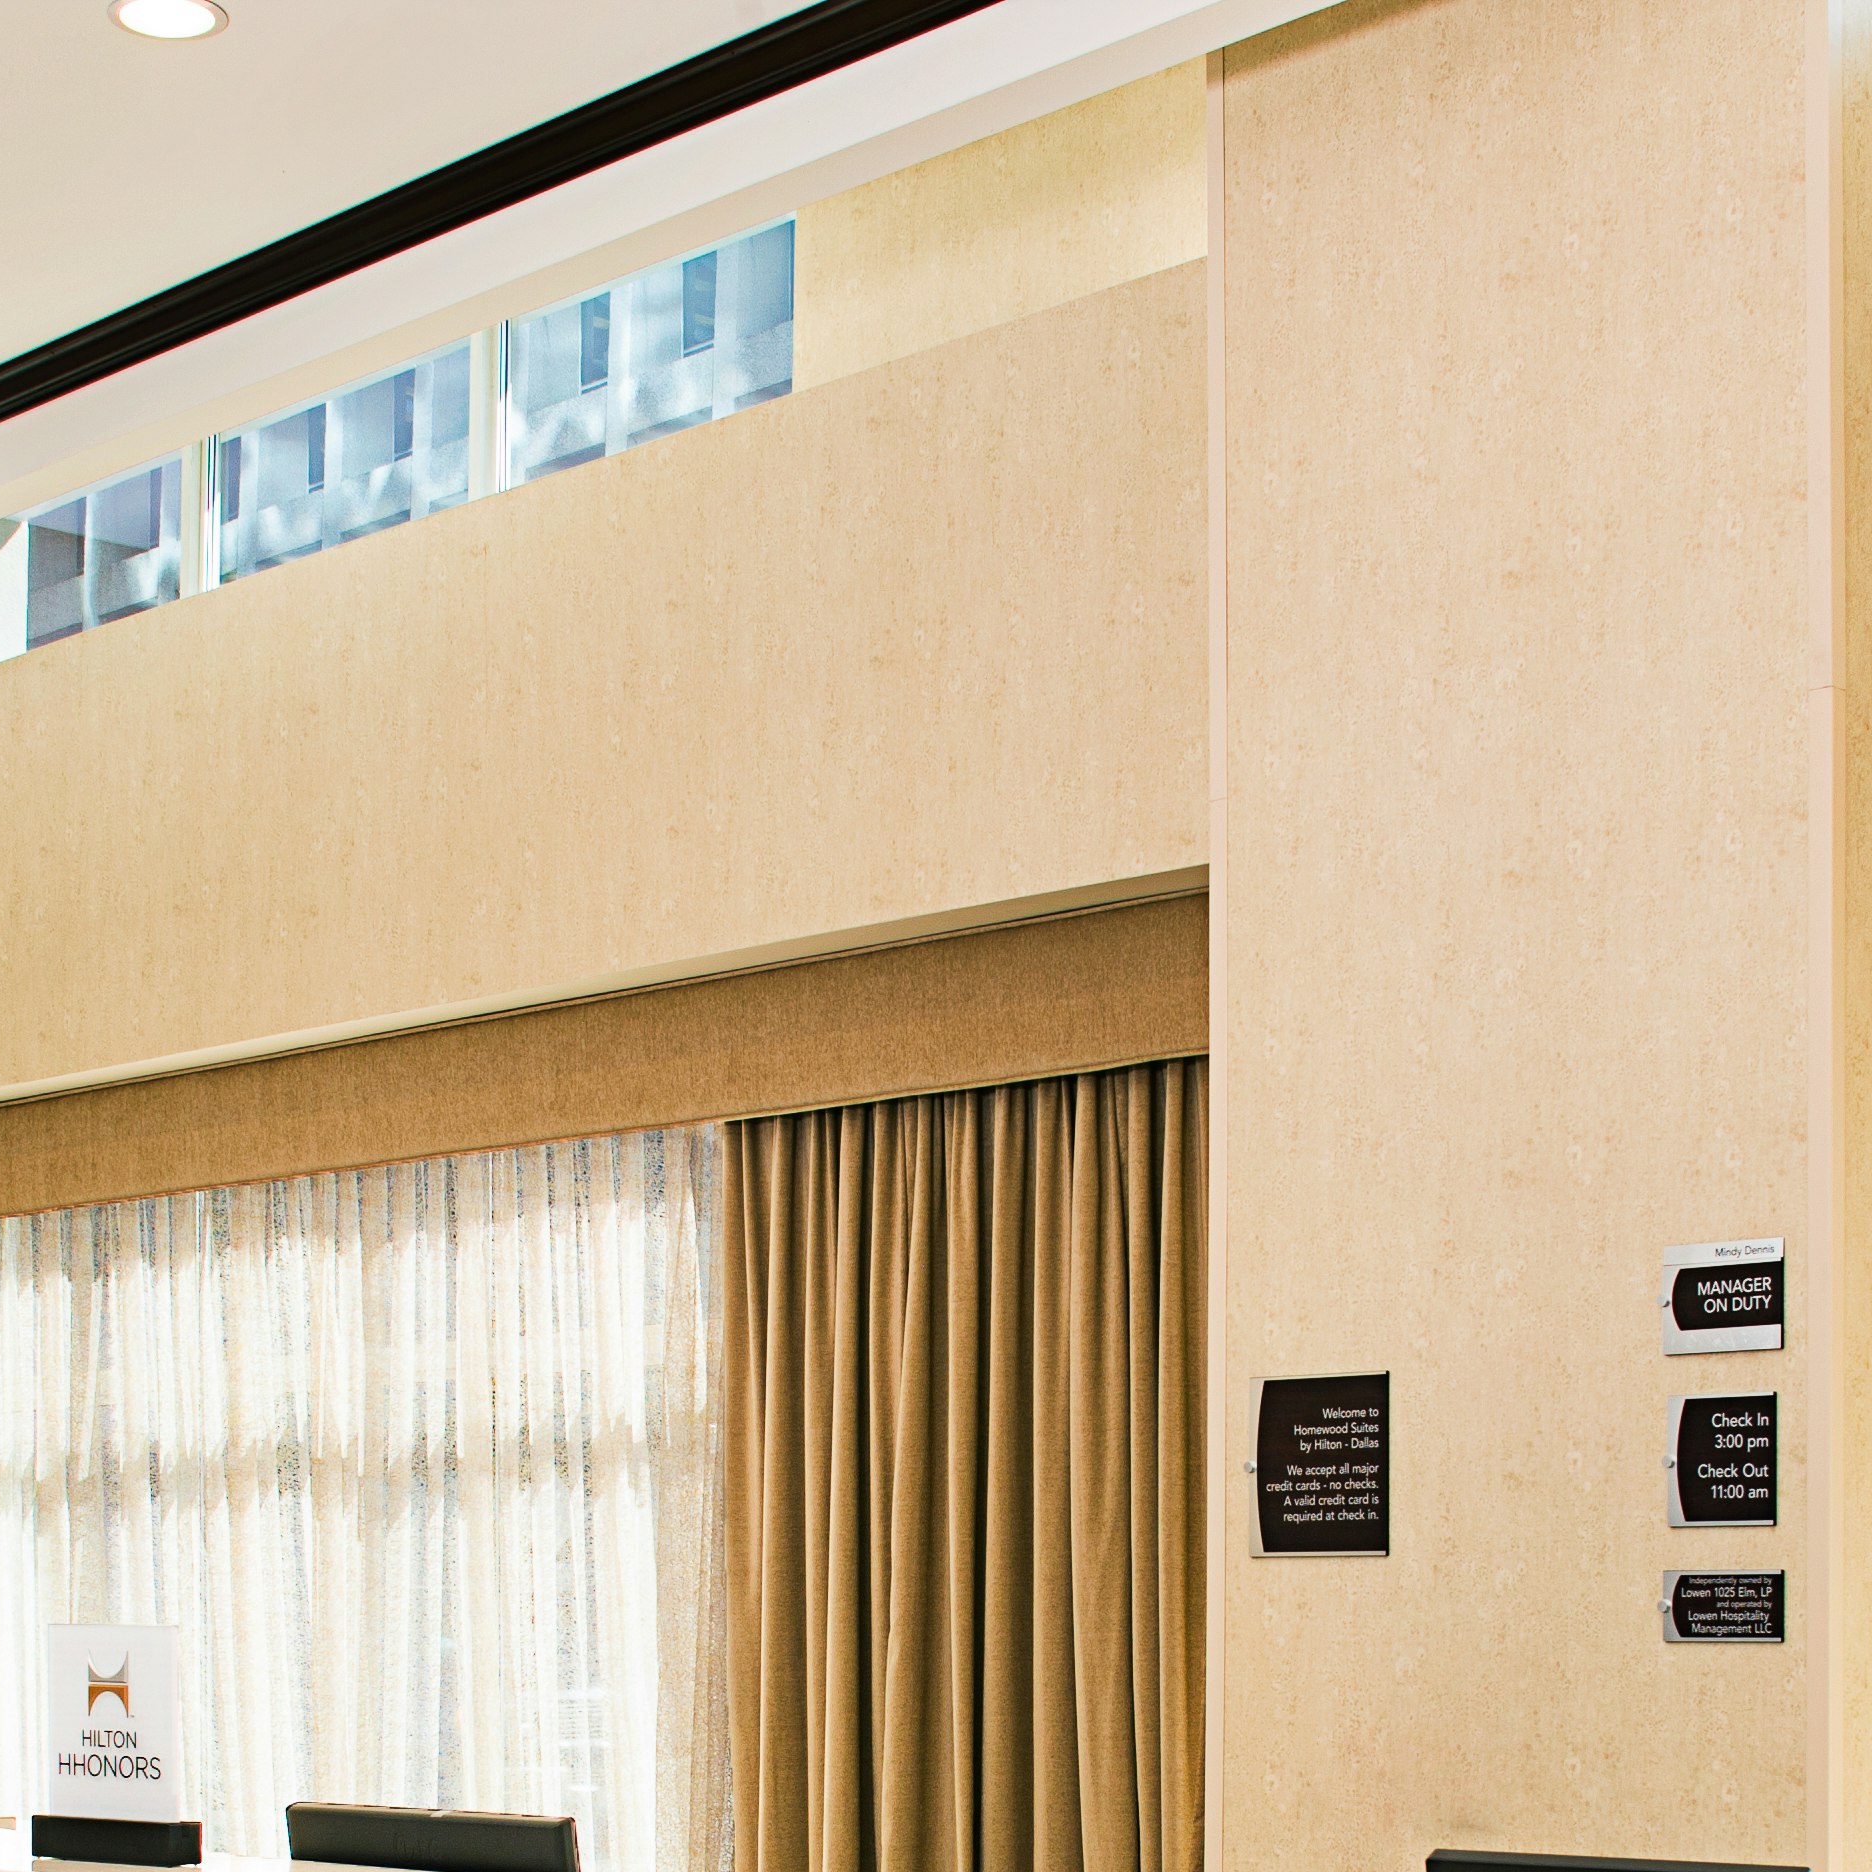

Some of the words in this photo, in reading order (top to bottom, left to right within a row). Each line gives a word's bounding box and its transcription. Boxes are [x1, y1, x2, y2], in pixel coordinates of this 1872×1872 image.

[1715, 1248, 1742, 1258] Mindy
[1745, 1245, 1774, 1255] Dennis
[1697, 1277, 1772, 1295] MANAGER
[1704, 1298, 1727, 1313] ON
[1732, 1295, 1772, 1311] DUTY
[1323, 1407, 1366, 1419] Welcome
[1369, 1408, 1379, 1417] to
[1712, 1412, 1752, 1427] Check
[1757, 1412, 1769, 1426] In
[1294, 1423, 1348, 1436] Homewood
[1351, 1422, 1379, 1433] Suites
[1300, 1441, 1311, 1453] by
[1314, 1440, 1342, 1450] Hilton
[1351, 1437, 1379, 1448] Dallas
[1714, 1434, 1743, 1448] 3:00
[1747, 1437, 1769, 1452] pm
[1287, 1465, 1303, 1475] We
[1305, 1465, 1336, 1478] accept
[1339, 1463, 1349, 1474] all
[1352, 1463, 1379, 1476] major
[1698, 1463, 1738, 1478] Check
[1743, 1463, 1769, 1478] Out
[1266, 1480, 1293, 1492] credit
[1296, 1479, 1321, 1491] cards
[1330, 1481, 1341, 1490] no
[1345, 1478, 1379, 1489] checks.
[1711, 1484, 1744, 1499] 11:00
[1748, 1488, 1768, 1498] am
[1284, 1496, 1292, 1506] A
[1294, 1495, 1316, 1506] valid
[1318, 1494, 1345, 1505] credit
[1348, 1493, 1369, 1504] card
[1372, 1494, 1379, 1504] is
[1283, 1510, 1323, 1524] required
[1325, 1512, 1335, 1521] at
[1338, 1508, 1365, 1521] check
[1368, 1510, 1379, 1519] in.
[1689, 1576, 1737, 1585] Independently
[1739, 1576, 1762, 1584] owned
[1764, 1576, 1772, 1585] by
[1681, 1588, 1711, 1598] Lowen
[1714, 1587, 1735, 1598] 1025
[1738, 1587, 1758, 1598] Elm,
[1761, 1587, 1772, 1597] LP
[1731, 1601, 1762, 1609] operated
[1764, 1601, 1772, 1609] by
[1688, 1611, 1717, 1620] Lowen
[1720, 1610, 1769, 1623] Hospitality
[1692, 1623, 1752, 1636] Management
[1754, 1623, 1772, 1634] LLC
[82, 1729, 137, 1749] HILTON
[59, 1753, 161, 1780] HHONORS
